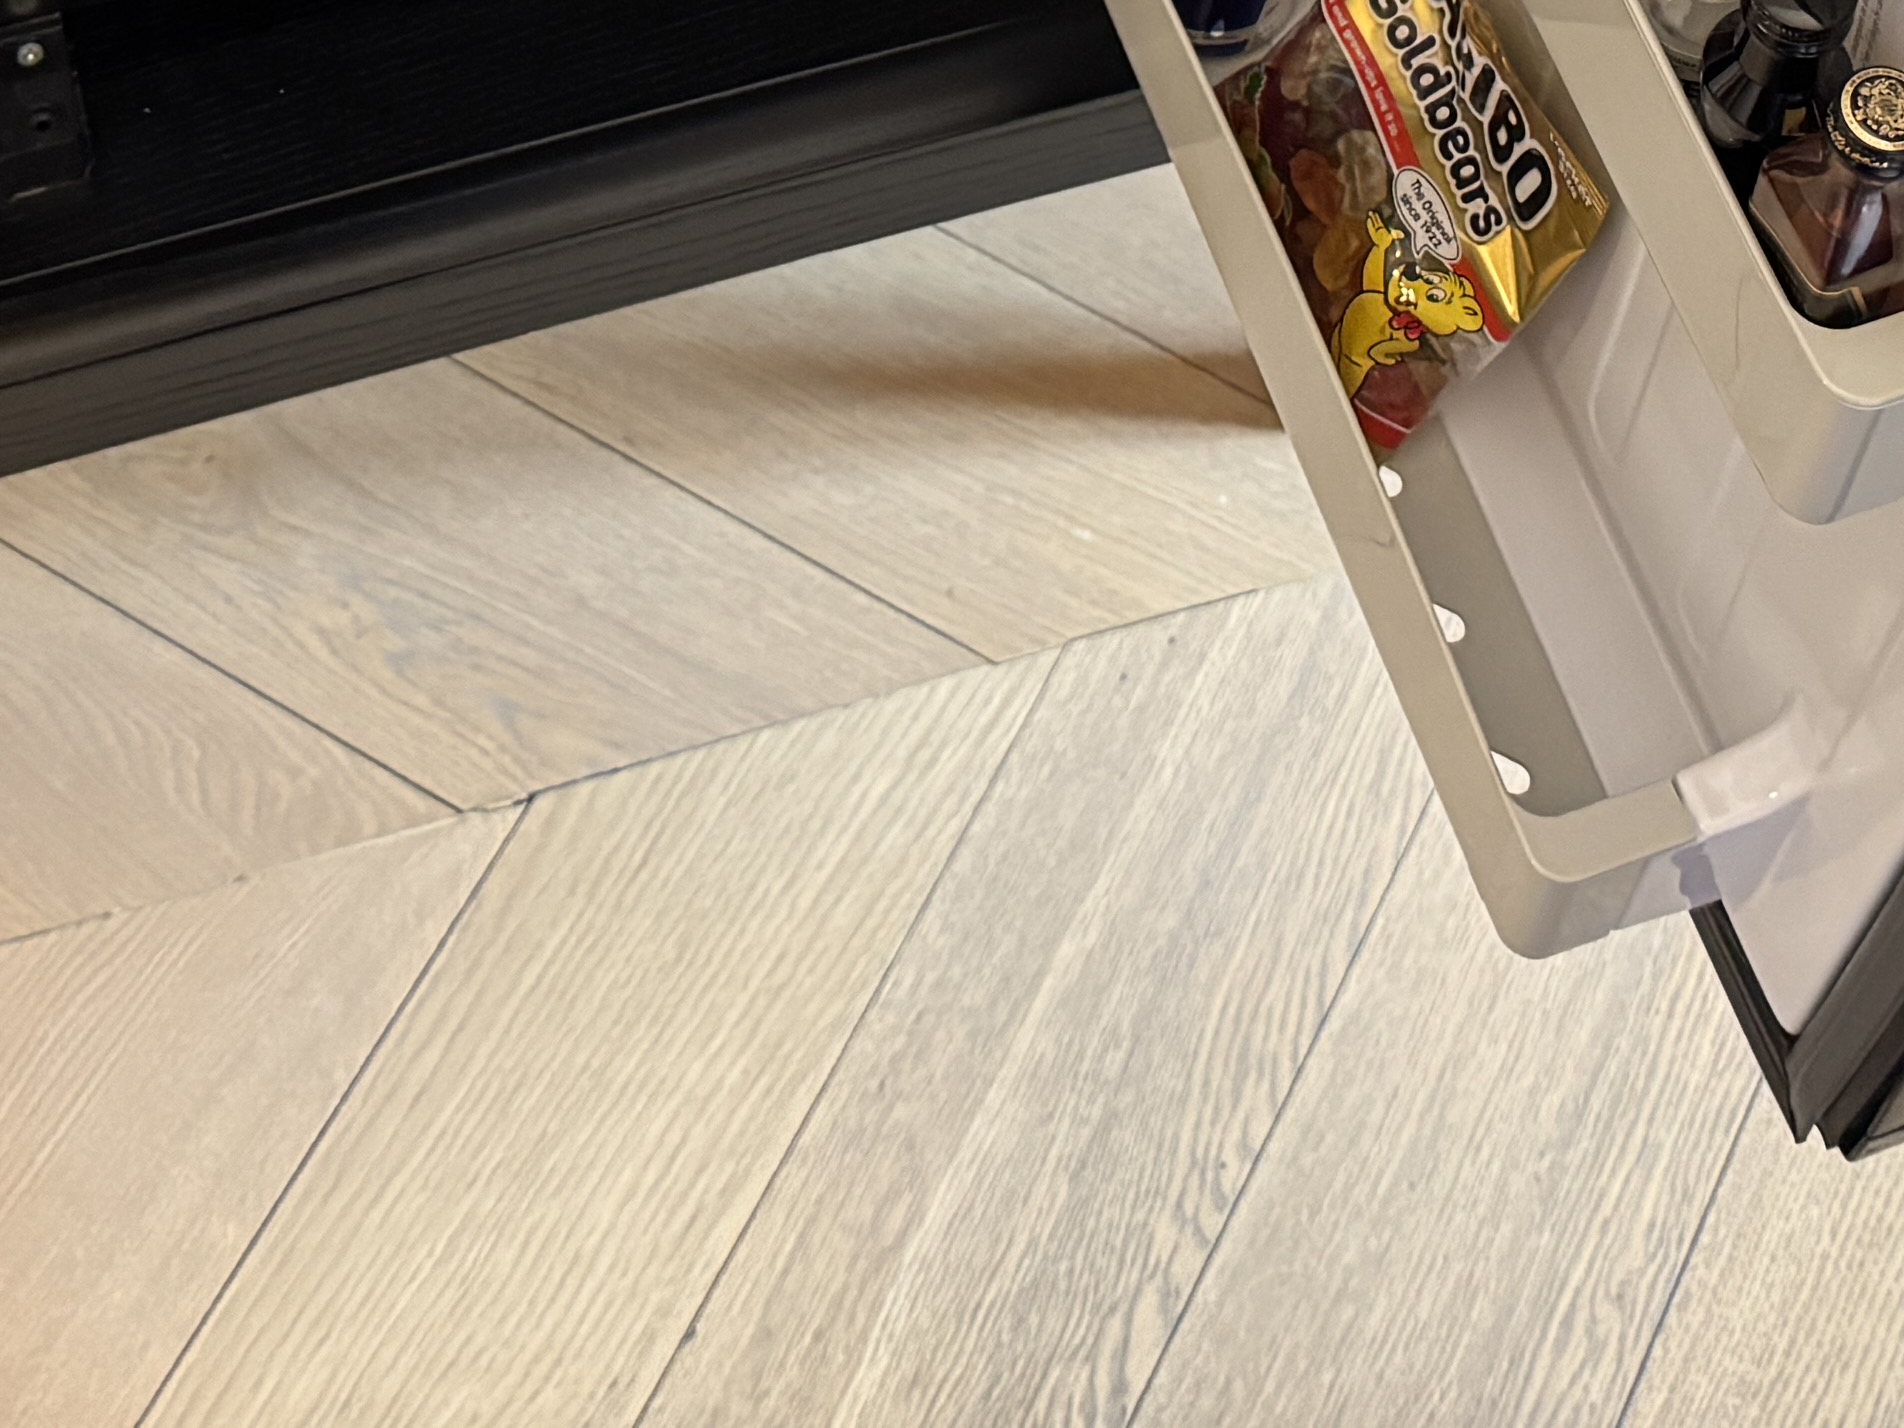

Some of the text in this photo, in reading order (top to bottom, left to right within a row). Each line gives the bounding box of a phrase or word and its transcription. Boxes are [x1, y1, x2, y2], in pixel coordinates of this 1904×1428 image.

[1400, 193, 1443, 250] since 1922
[1410, 178, 1453, 245] The Original
